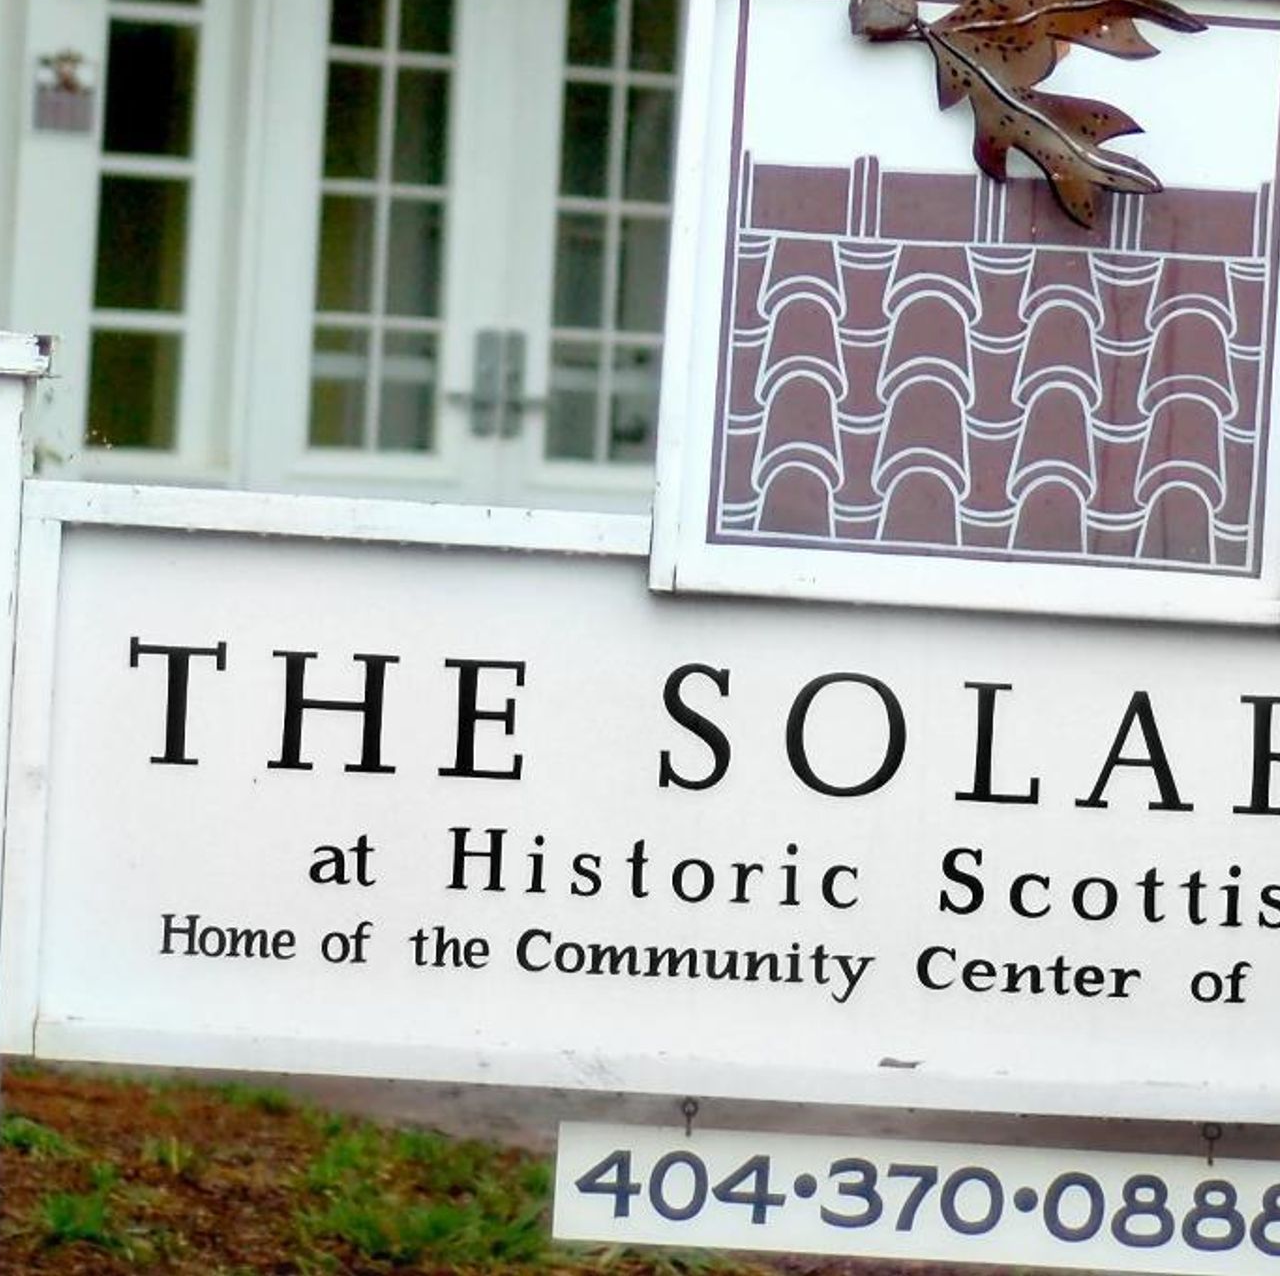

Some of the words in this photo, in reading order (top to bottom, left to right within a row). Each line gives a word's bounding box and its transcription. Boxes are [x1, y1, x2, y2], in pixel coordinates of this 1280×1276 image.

[130, 637, 525, 780] THE
[309, 835, 376, 886] at
[447, 828, 857, 909] Historic
[161, 914, 295, 959] Home
[322, 921, 373, 963] of
[409, 926, 489, 969] the
[517, 929, 875, 1003] Community
[917, 946, 1141, 997] Center
[1191, 961, 1251, 1003] of
